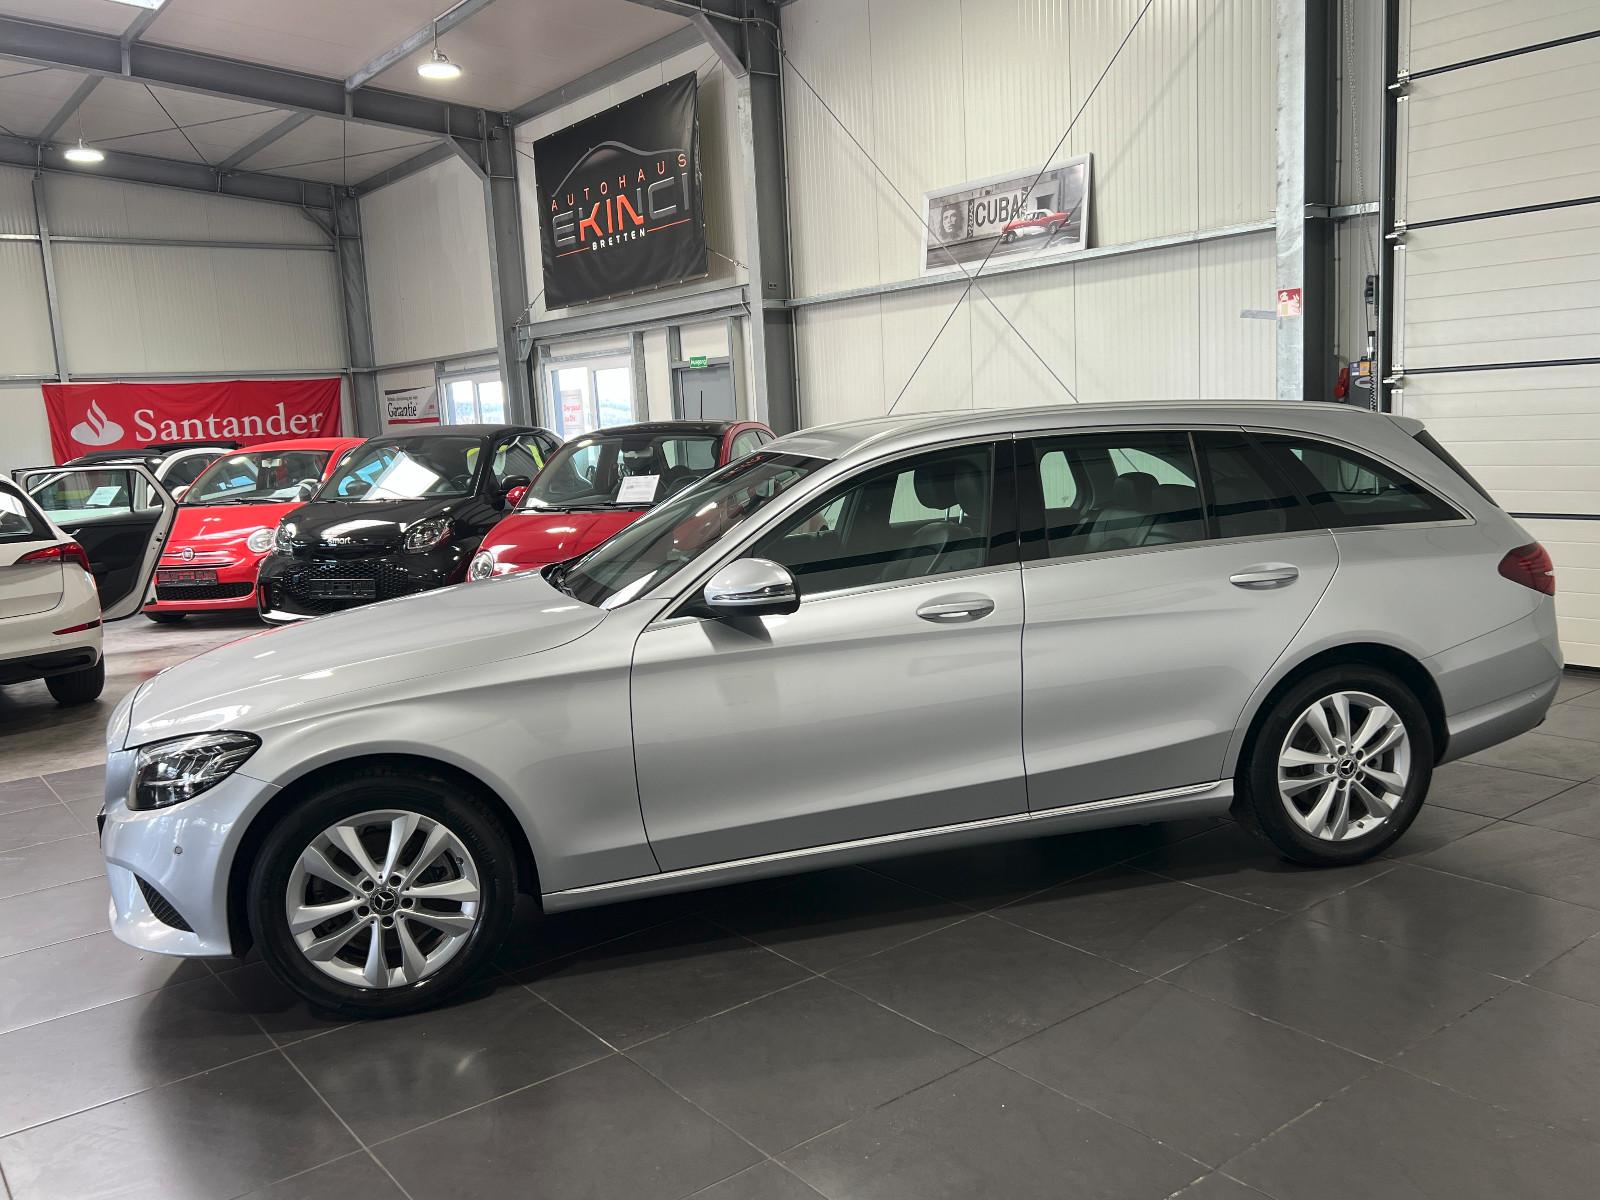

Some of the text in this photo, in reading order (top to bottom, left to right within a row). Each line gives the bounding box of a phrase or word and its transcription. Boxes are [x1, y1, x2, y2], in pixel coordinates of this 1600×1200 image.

[551, 153, 687, 212] AUTOHAUS
[552, 173, 690, 248] EKINCI
[975, 194, 1021, 227] CUBA
[592, 227, 646, 251] BRETTEN
[134, 402, 324, 442] Santander
[387, 402, 417, 418] Garantie
[327, 536, 352, 545] smart
